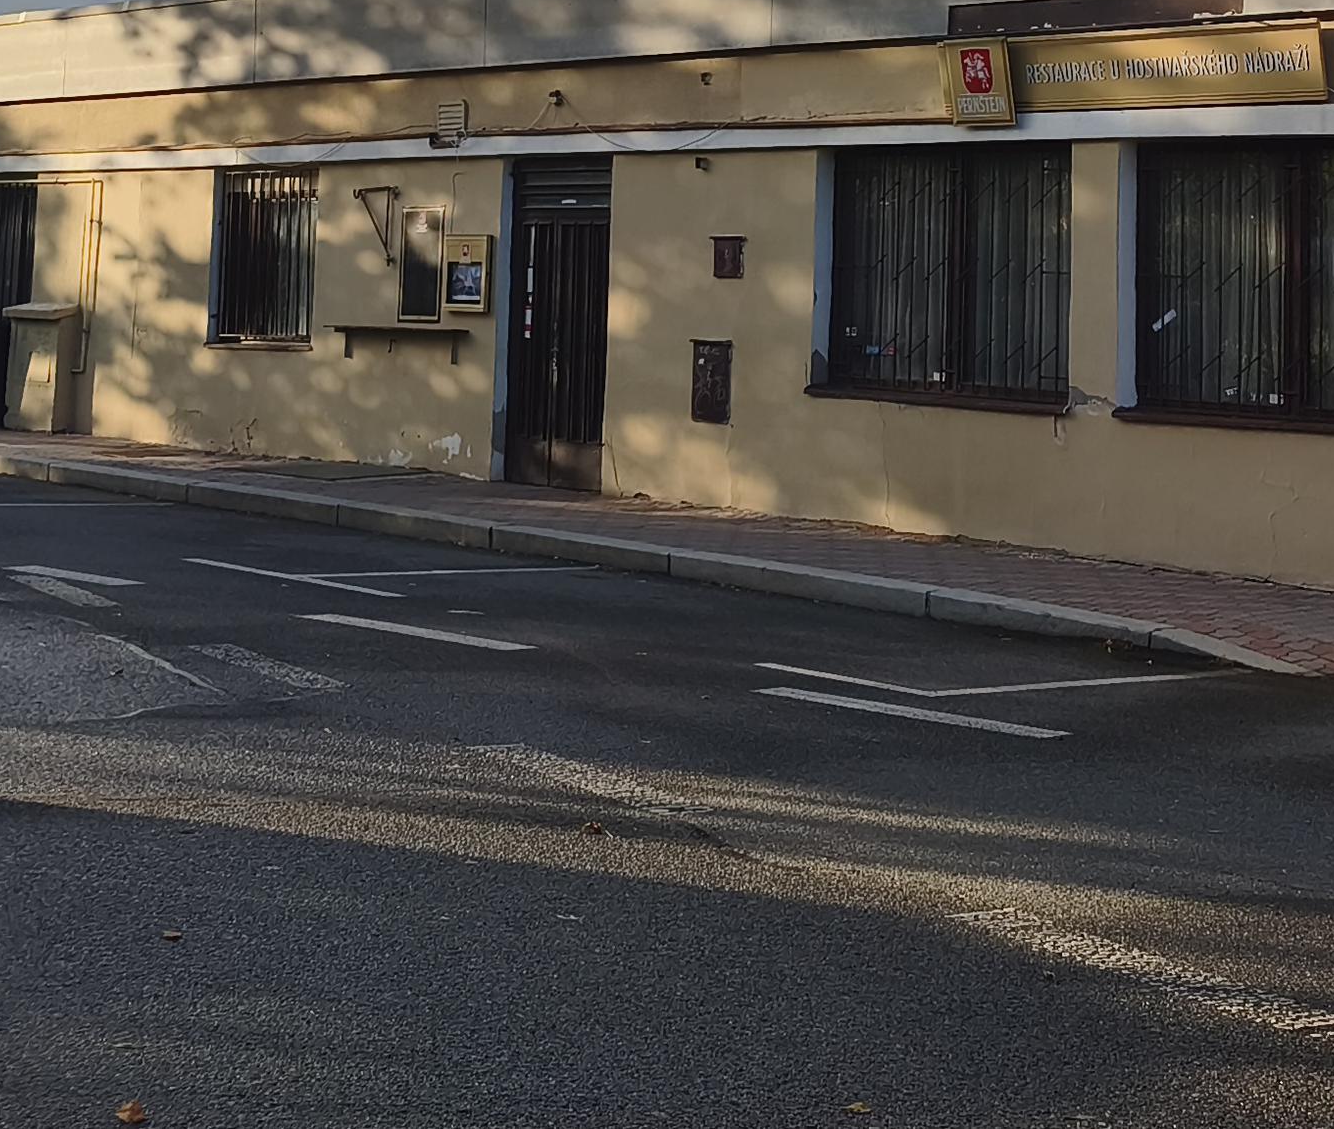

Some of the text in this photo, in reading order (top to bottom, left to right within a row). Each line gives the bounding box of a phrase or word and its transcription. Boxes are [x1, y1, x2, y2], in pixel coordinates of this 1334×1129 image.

[1026, 43, 1310, 84] RESTAURACE U HOSTIVAŘSKÉHO NÁDRAŽÍ
[957, 95, 1006, 114] PERNŠTEJN
